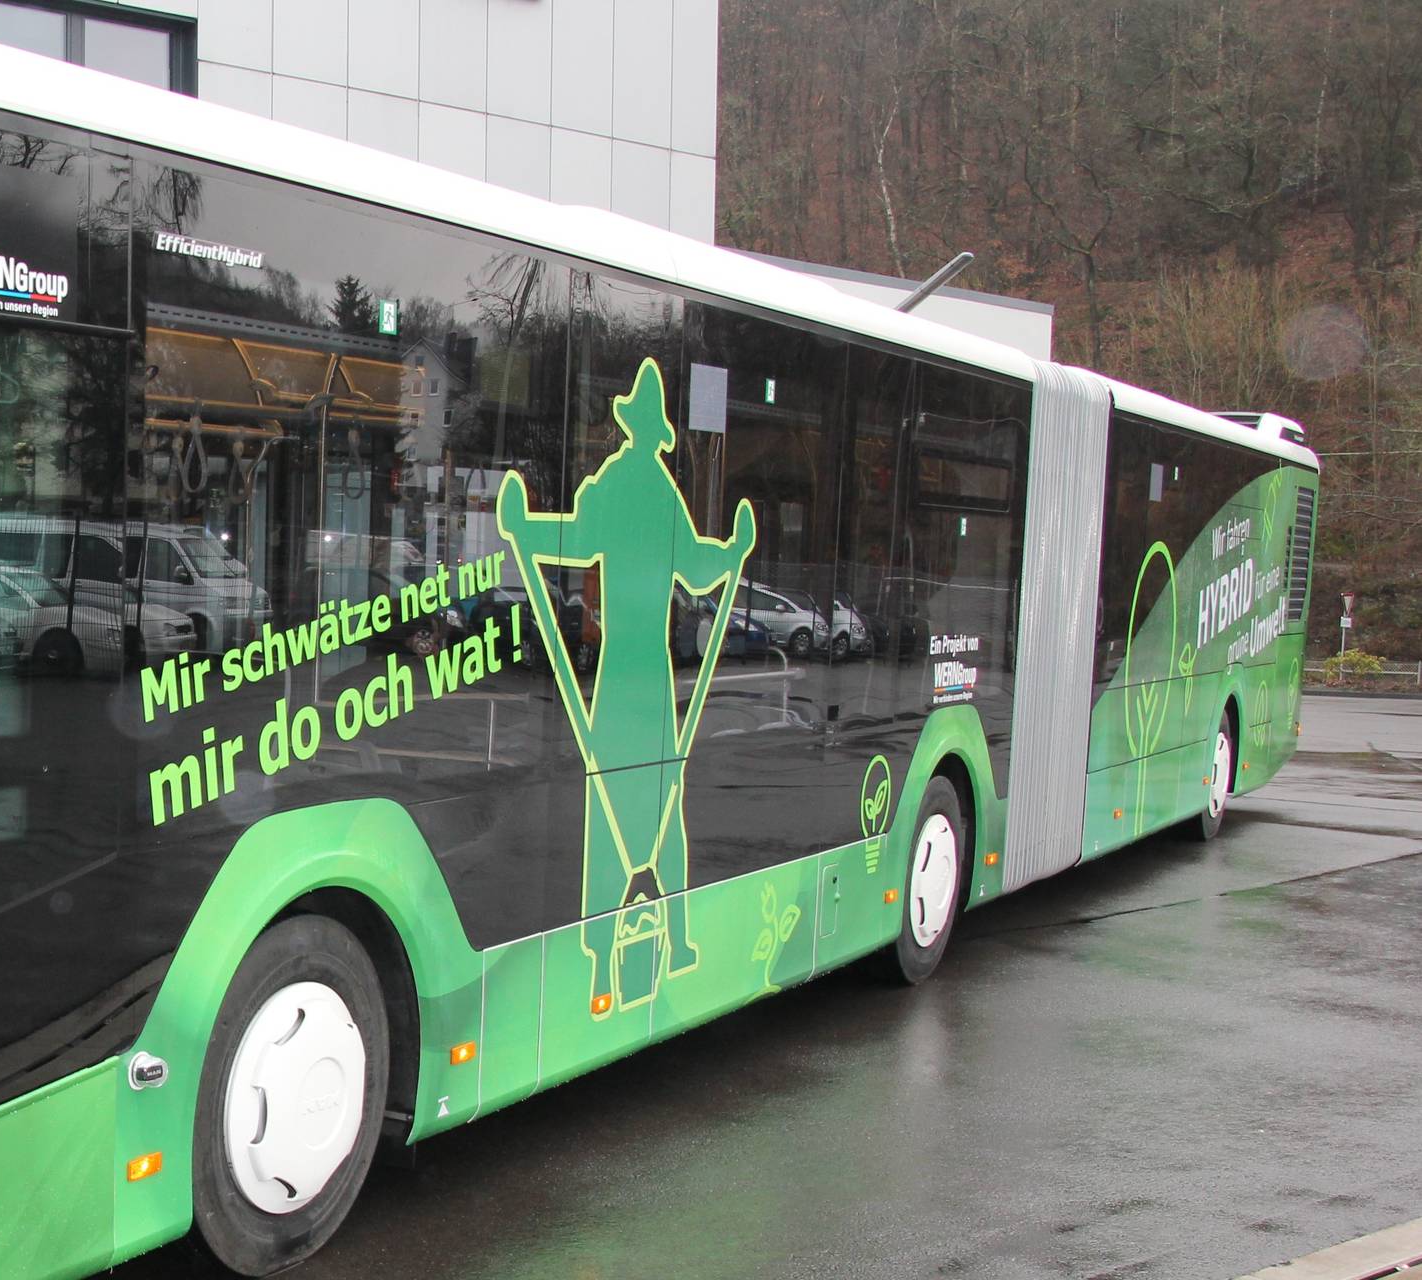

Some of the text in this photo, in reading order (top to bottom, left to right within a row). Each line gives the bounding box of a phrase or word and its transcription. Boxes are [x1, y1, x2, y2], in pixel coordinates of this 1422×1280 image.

[156, 233, 262, 268] EfficientHybrid
[4, 301, 31, 314] unsere
[32, 303, 58, 318] Region
[1211, 516, 1250, 561] Wir fahren
[1196, 558, 1254, 649] HYBRID
[140, 550, 506, 723] Mir schwätze net nur
[930, 634, 978, 657] Ein Projekt von
[1249, 595, 1286, 658] Umwelt
[934, 661, 976, 688] WERNGroup
[149, 726, 244, 827] mir
[258, 698, 321, 777] do
[335, 652, 415, 742] och
[425, 617, 501, 700] wat
